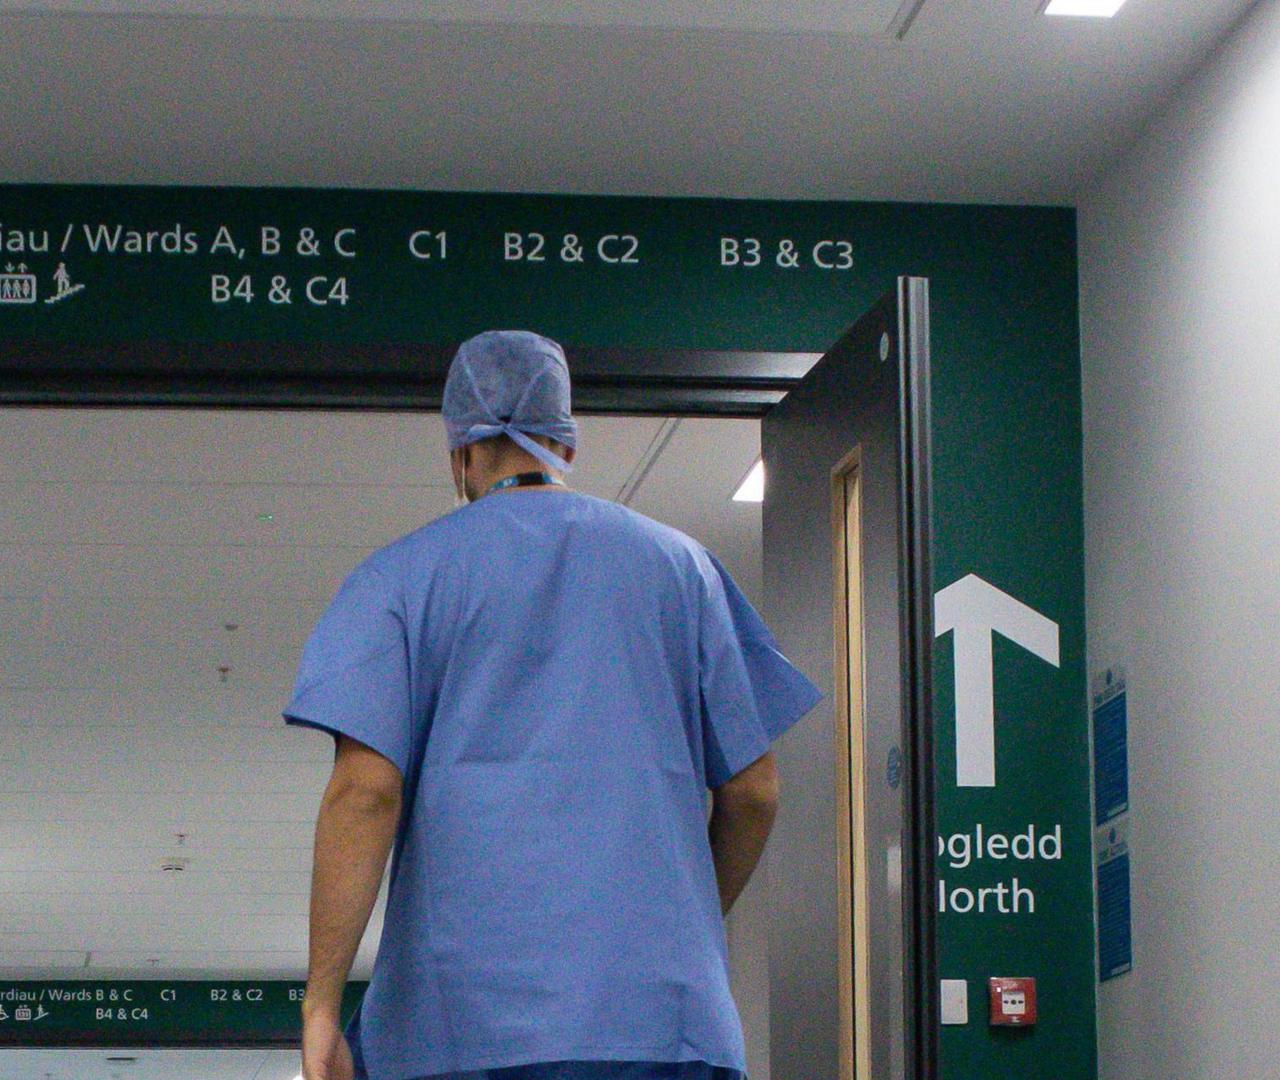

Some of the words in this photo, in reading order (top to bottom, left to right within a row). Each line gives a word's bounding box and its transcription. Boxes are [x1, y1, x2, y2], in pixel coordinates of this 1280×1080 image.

[83, 223, 198, 254] Wards
[210, 226, 245, 259] A,
[261, 226, 280, 255] B
[296, 227, 320, 256] &
[334, 228, 356, 258] C
[408, 230, 447, 259] C1
[504, 232, 546, 261] B2
[560, 233, 584, 263] &
[596, 235, 639, 263] C2
[720, 237, 761, 267] B3
[775, 239, 799, 268] &
[812, 241, 854, 269] C3
[211, 274, 254, 303] B4
[268, 275, 292, 304] &
[306, 275, 349, 305] C4
[938, 823, 1062, 869] gledd
[938, 877, 1035, 913] orth
[48, 989, 91, 1001] Wards
[96, 989, 104, 1000] B
[109, 989, 119, 1001] &
[123, 989, 133, 1001] C
[160, 989, 177, 1001] C1
[210, 989, 228, 1001] B2
[232, 990, 242, 1001] &
[246, 989, 263, 1001] C2
[96, 1008, 112, 1020] B4
[117, 1008, 127, 1020] &
[131, 1008, 148, 1020] C4
